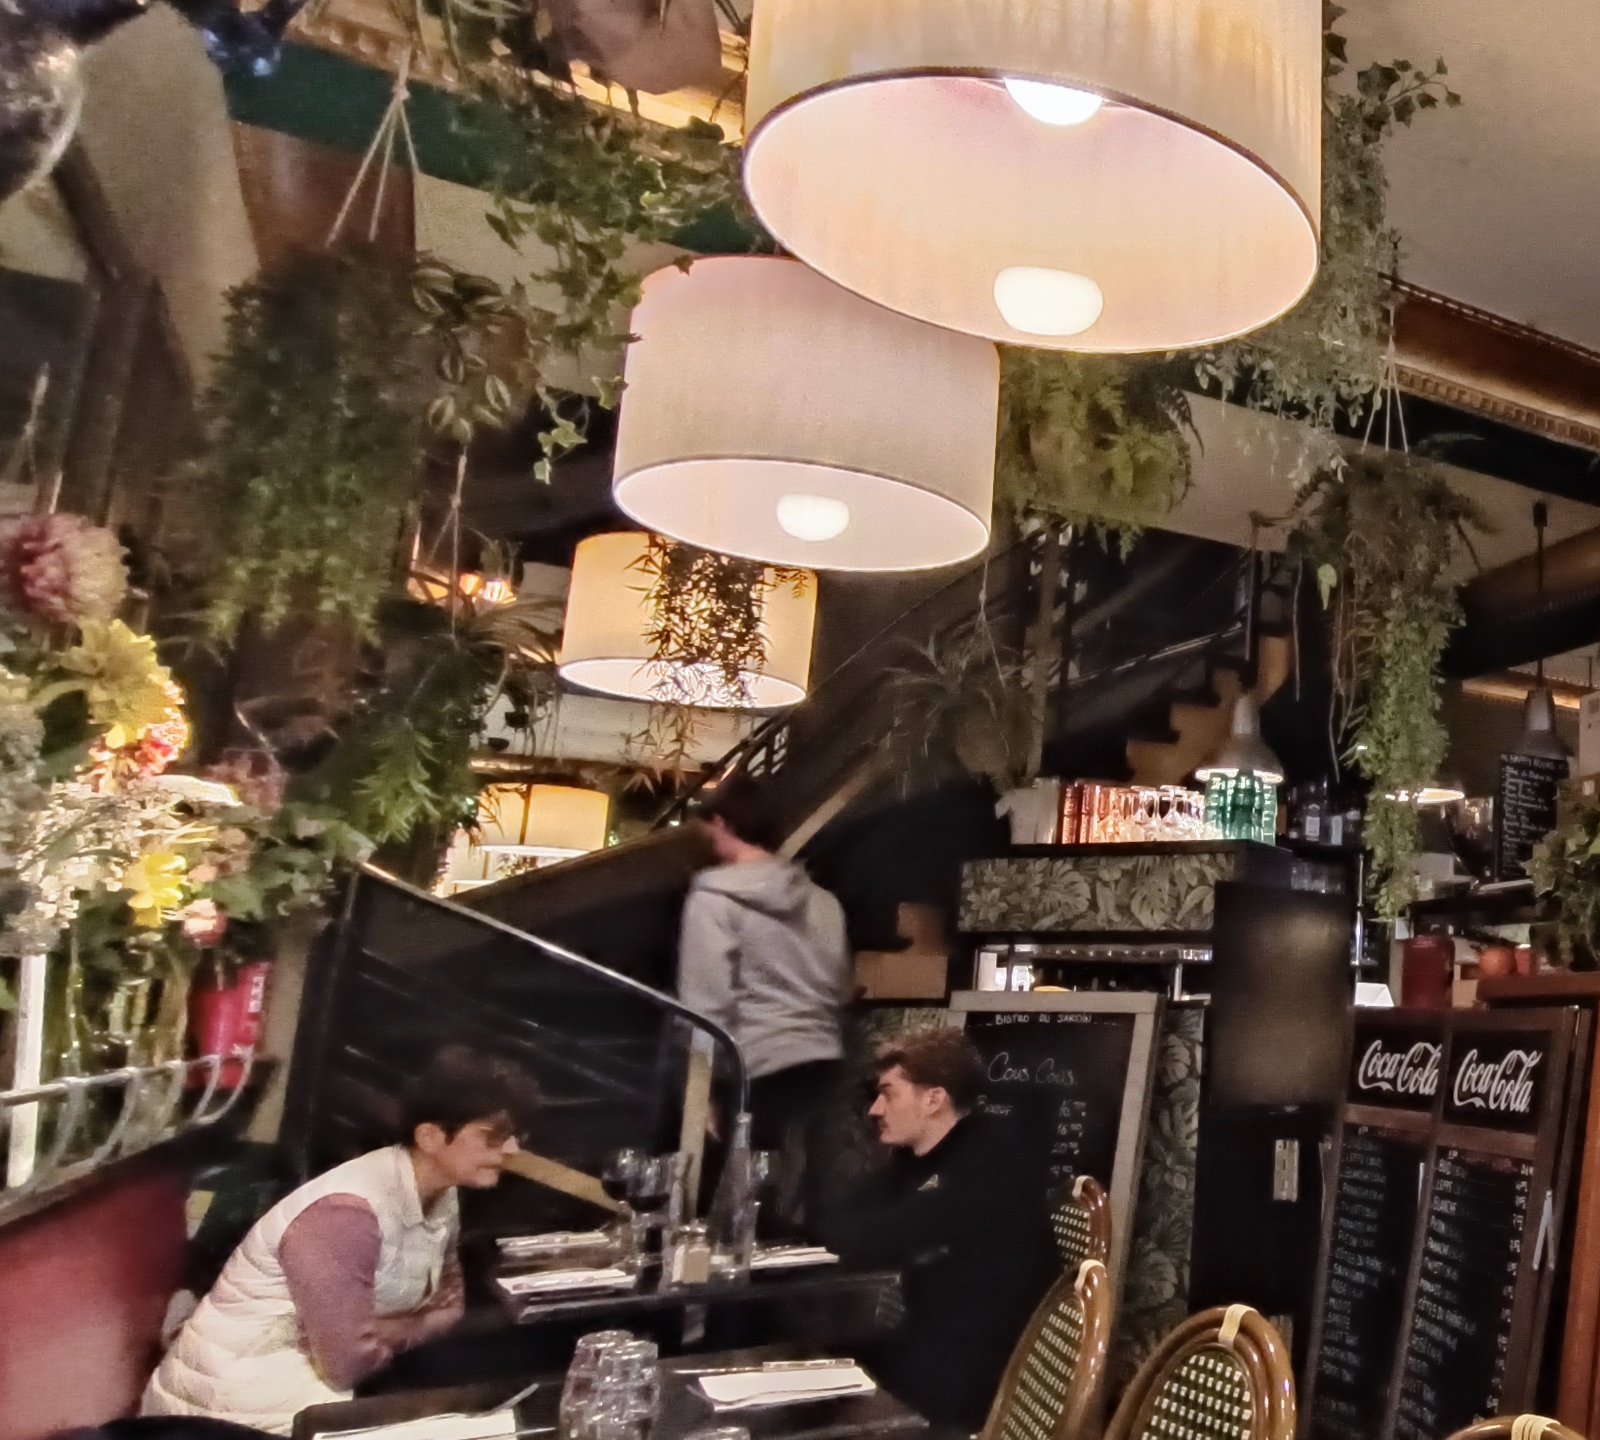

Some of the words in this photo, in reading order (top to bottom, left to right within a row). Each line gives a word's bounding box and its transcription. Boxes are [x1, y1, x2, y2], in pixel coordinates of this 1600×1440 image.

[995, 1014, 1030, 1025] BISTRO
[1056, 1013, 1092, 1024] JARDIN
[988, 1051, 1030, 1083] Cous
[1035, 1058, 1075, 1086] Cous
[1358, 1039, 1442, 1096] Coca-Cola
[1453, 1048, 1543, 1112] Coca-Cola
